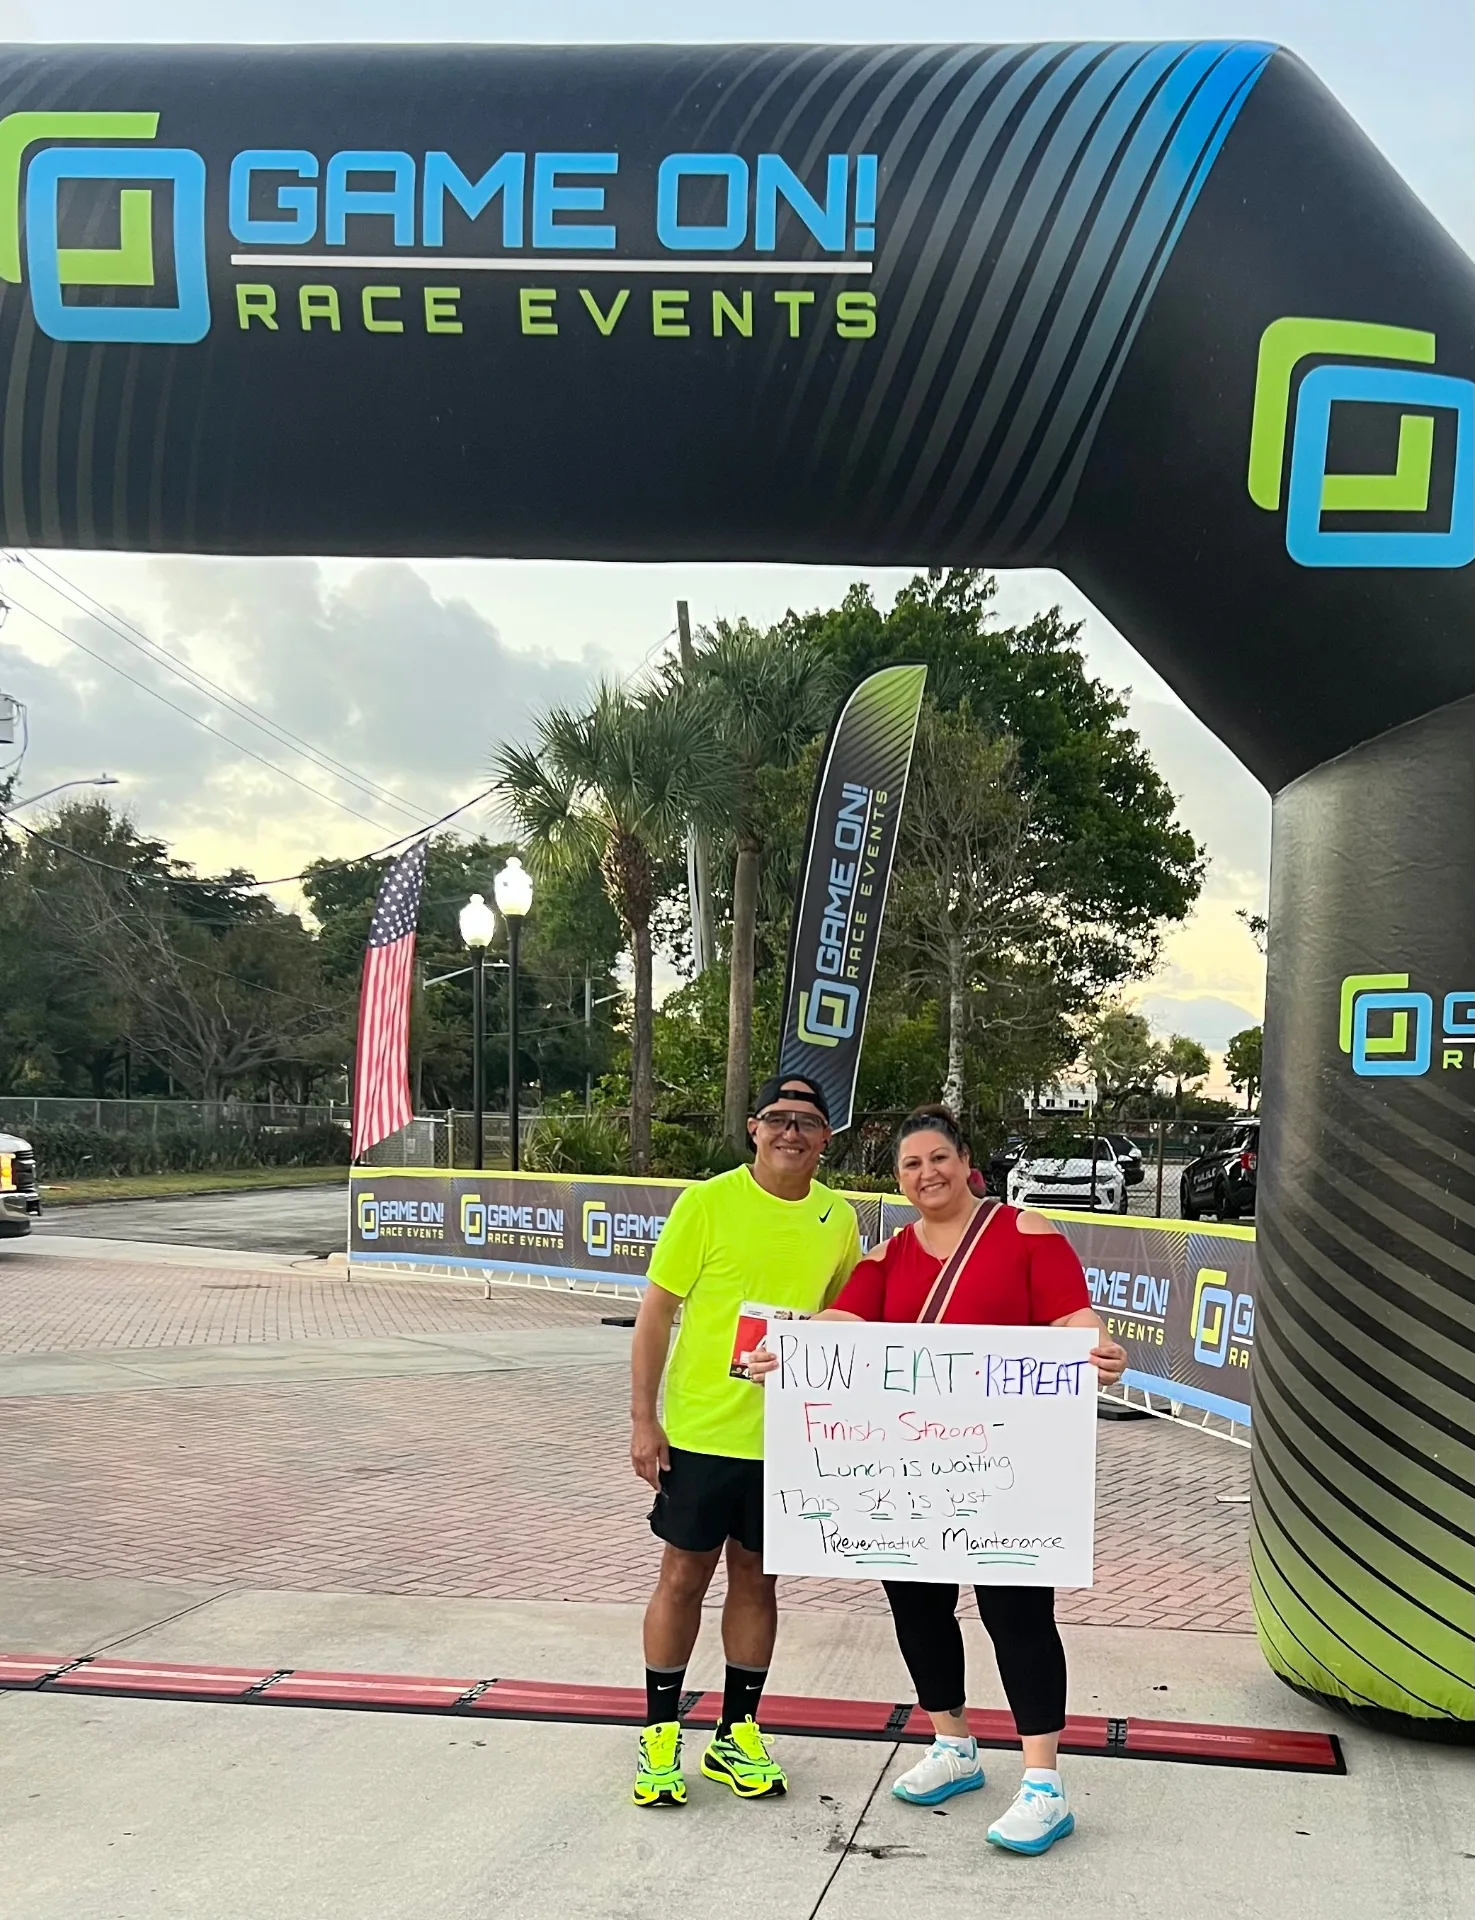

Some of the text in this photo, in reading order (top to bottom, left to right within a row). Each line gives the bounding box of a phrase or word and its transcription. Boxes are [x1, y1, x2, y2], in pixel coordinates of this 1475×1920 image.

[229, 149, 879, 252] GAME ON!
[236, 283, 878, 340] RACE EVENTS
[815, 782, 869, 976] GAME ON!
[846, 790, 888, 979] RACE EVENTS
[379, 1200, 444, 1223] GAME ON!
[487, 1204, 564, 1232] GAME ON!
[379, 1226, 444, 1240] RACE EVENTS
[487, 1233, 564, 1249] RACE EVENTS
[613, 1243, 645, 1257] RACE
[1082, 1266, 1170, 1316] AME ON!
[1107, 1317, 1164, 1346] EVENTS
[779, 1334, 1090, 1397] RUN EAT REPEAT
[804, 1402, 885, 1443] Finish
[814, 1447, 1014, 1490] Lunch is waiting
[772, 1488, 840, 1514] This
[908, 1492, 931, 1509] is
[941, 1488, 992, 1517] just
[942, 1527, 1066, 1551] Maintenance
